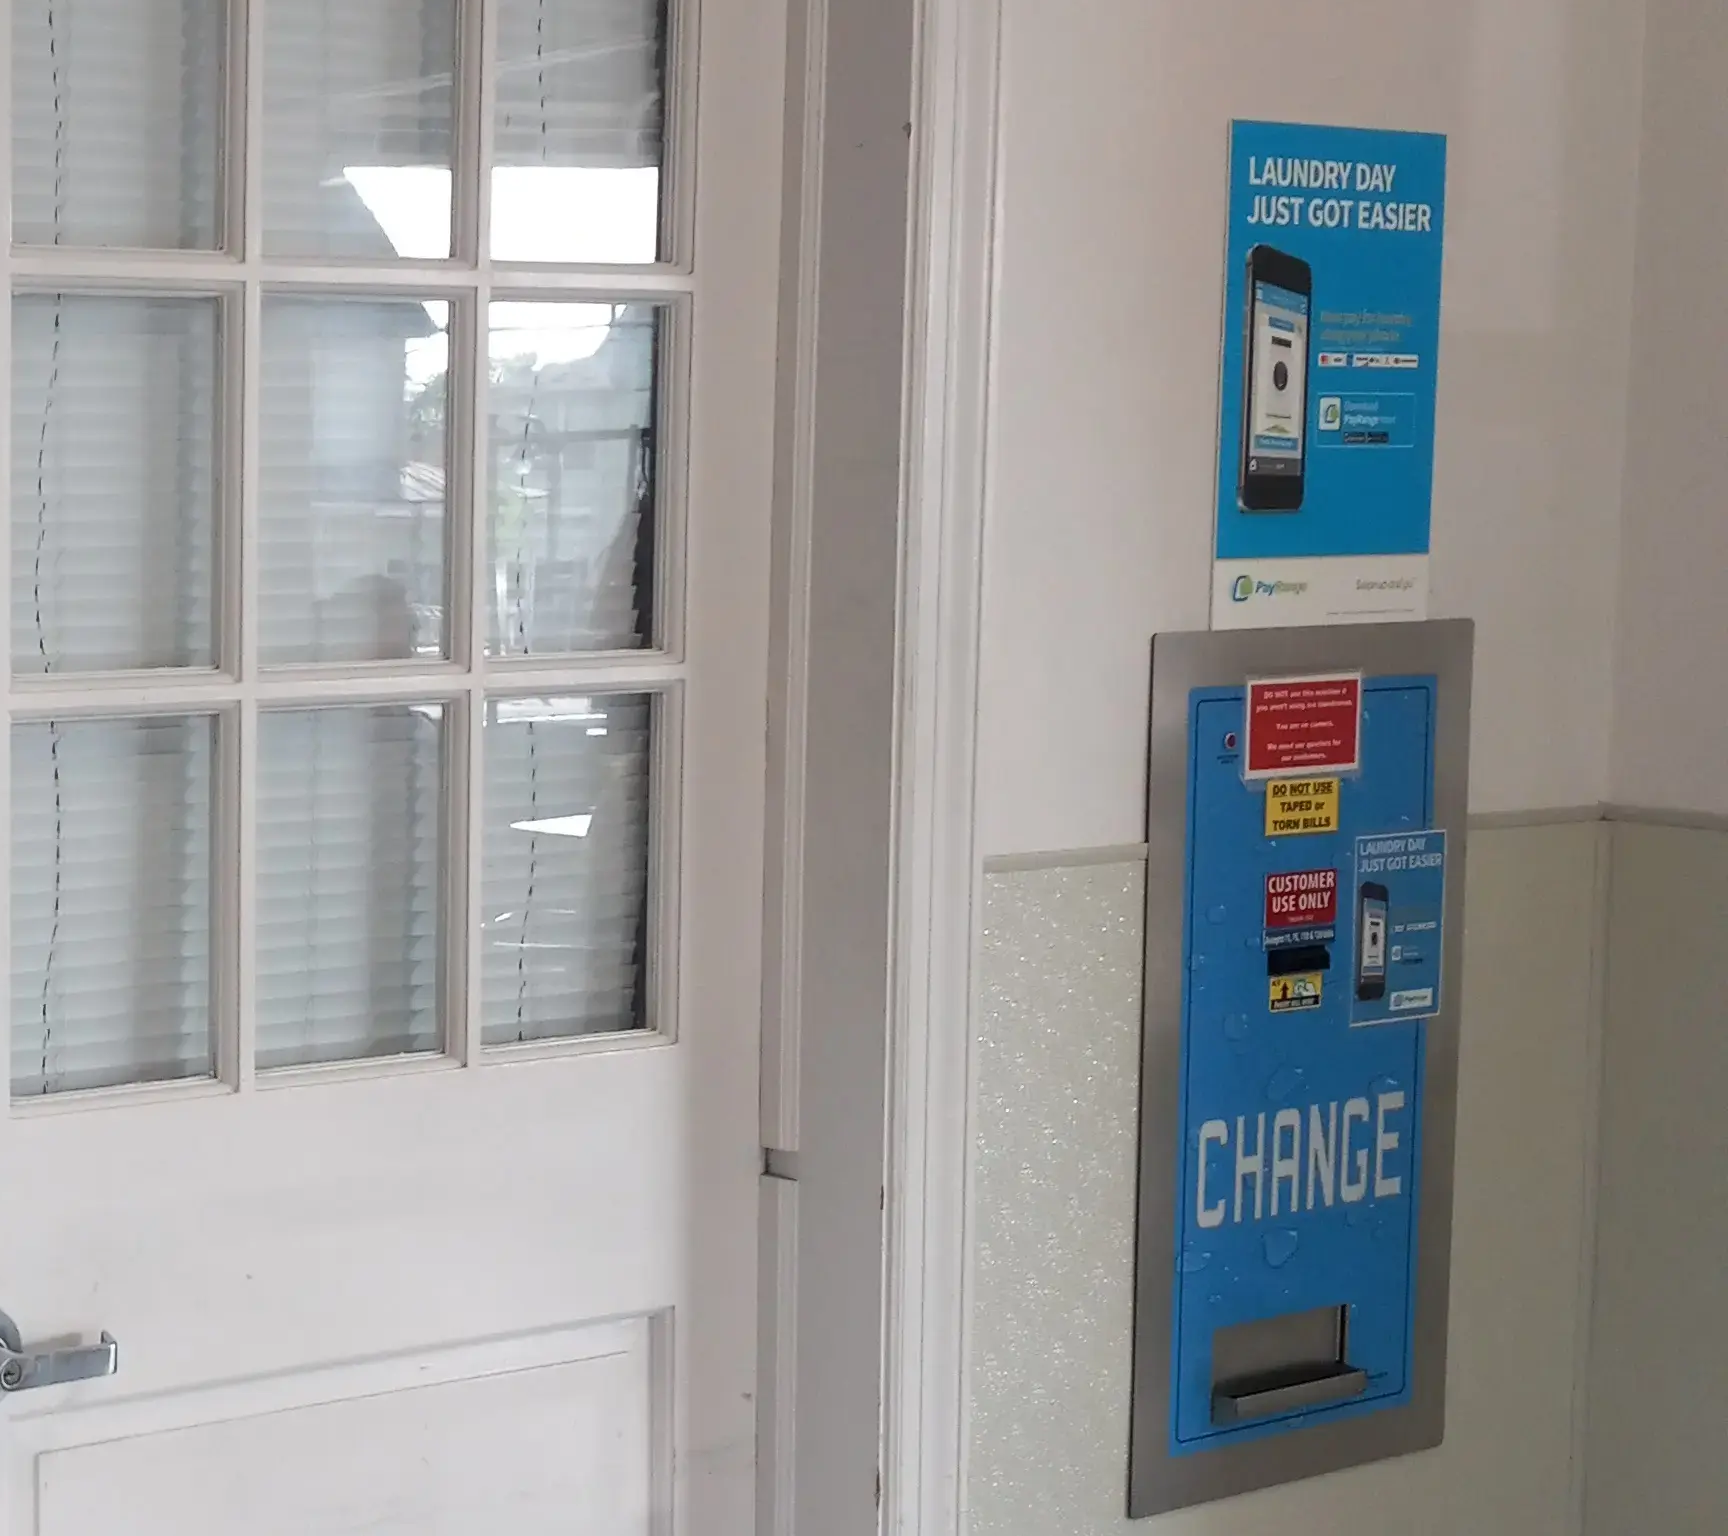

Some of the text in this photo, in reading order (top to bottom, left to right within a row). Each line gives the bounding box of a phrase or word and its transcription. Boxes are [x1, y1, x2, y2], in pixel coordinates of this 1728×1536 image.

[1249, 156, 1396, 193] LAUNDRY DAY
[1247, 195, 1431, 232] JUST GOT EASIER
[1272, 781, 1333, 796] DO NOT USE
[1280, 800, 1311, 813] TAPED
[1272, 816, 1330, 831] TORN BILLS
[1360, 838, 1426, 856] LAUNDRY DAY
[1359, 853, 1443, 872] JUST GOT EASIER
[1268, 871, 1335, 893] CUSTOMER
[1272, 891, 1331, 913] USE ONLY
[1196, 1090, 1405, 1229] CHANGE
